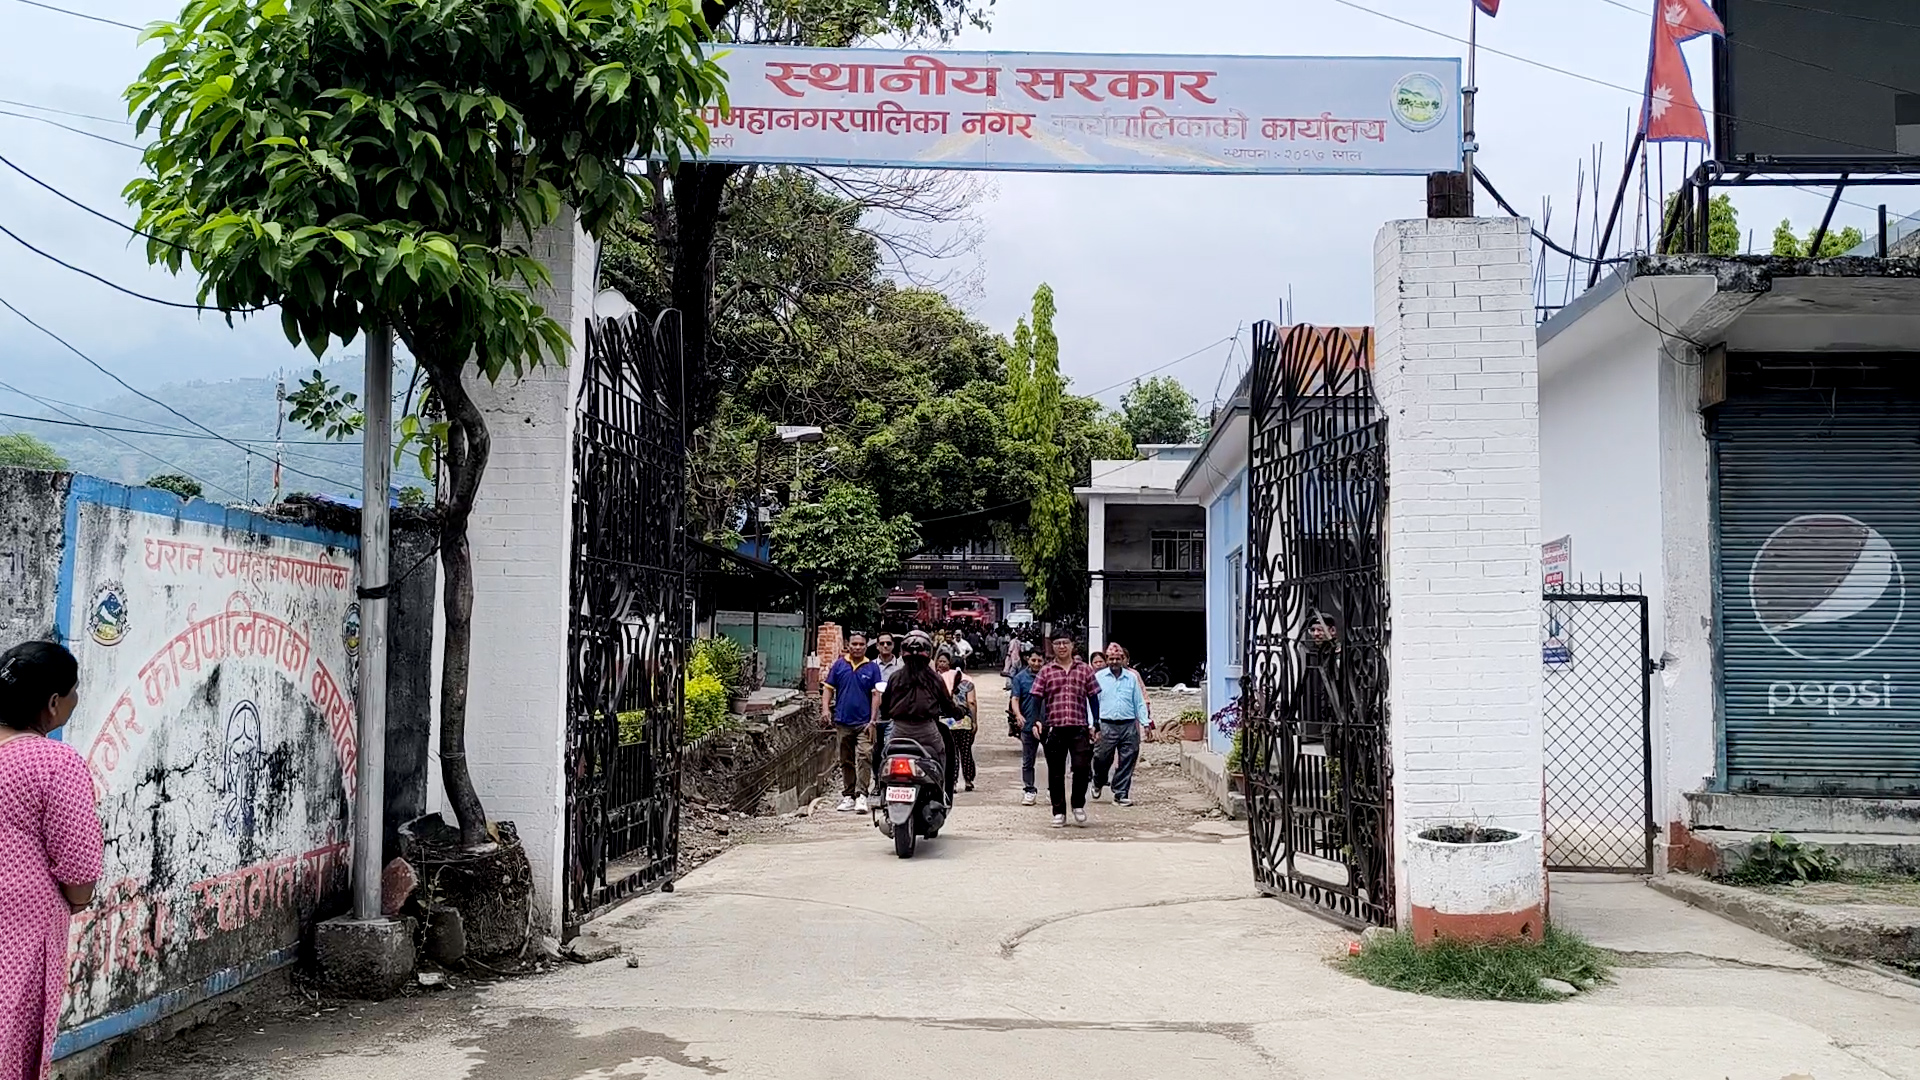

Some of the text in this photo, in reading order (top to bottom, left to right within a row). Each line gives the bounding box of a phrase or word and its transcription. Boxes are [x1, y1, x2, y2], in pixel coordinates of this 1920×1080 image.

[765, 55, 1218, 103] स्थानीय सरकार
[700, 101, 950, 135] पमहानगरपालिका
[962, 112, 1036, 138] नगर
[1261, 111, 1387, 142] कार्यालय
[1331, 150, 1363, 162] साल
[144, 537, 204, 575] धरान
[1767, 673, 1892, 715] pepsi
